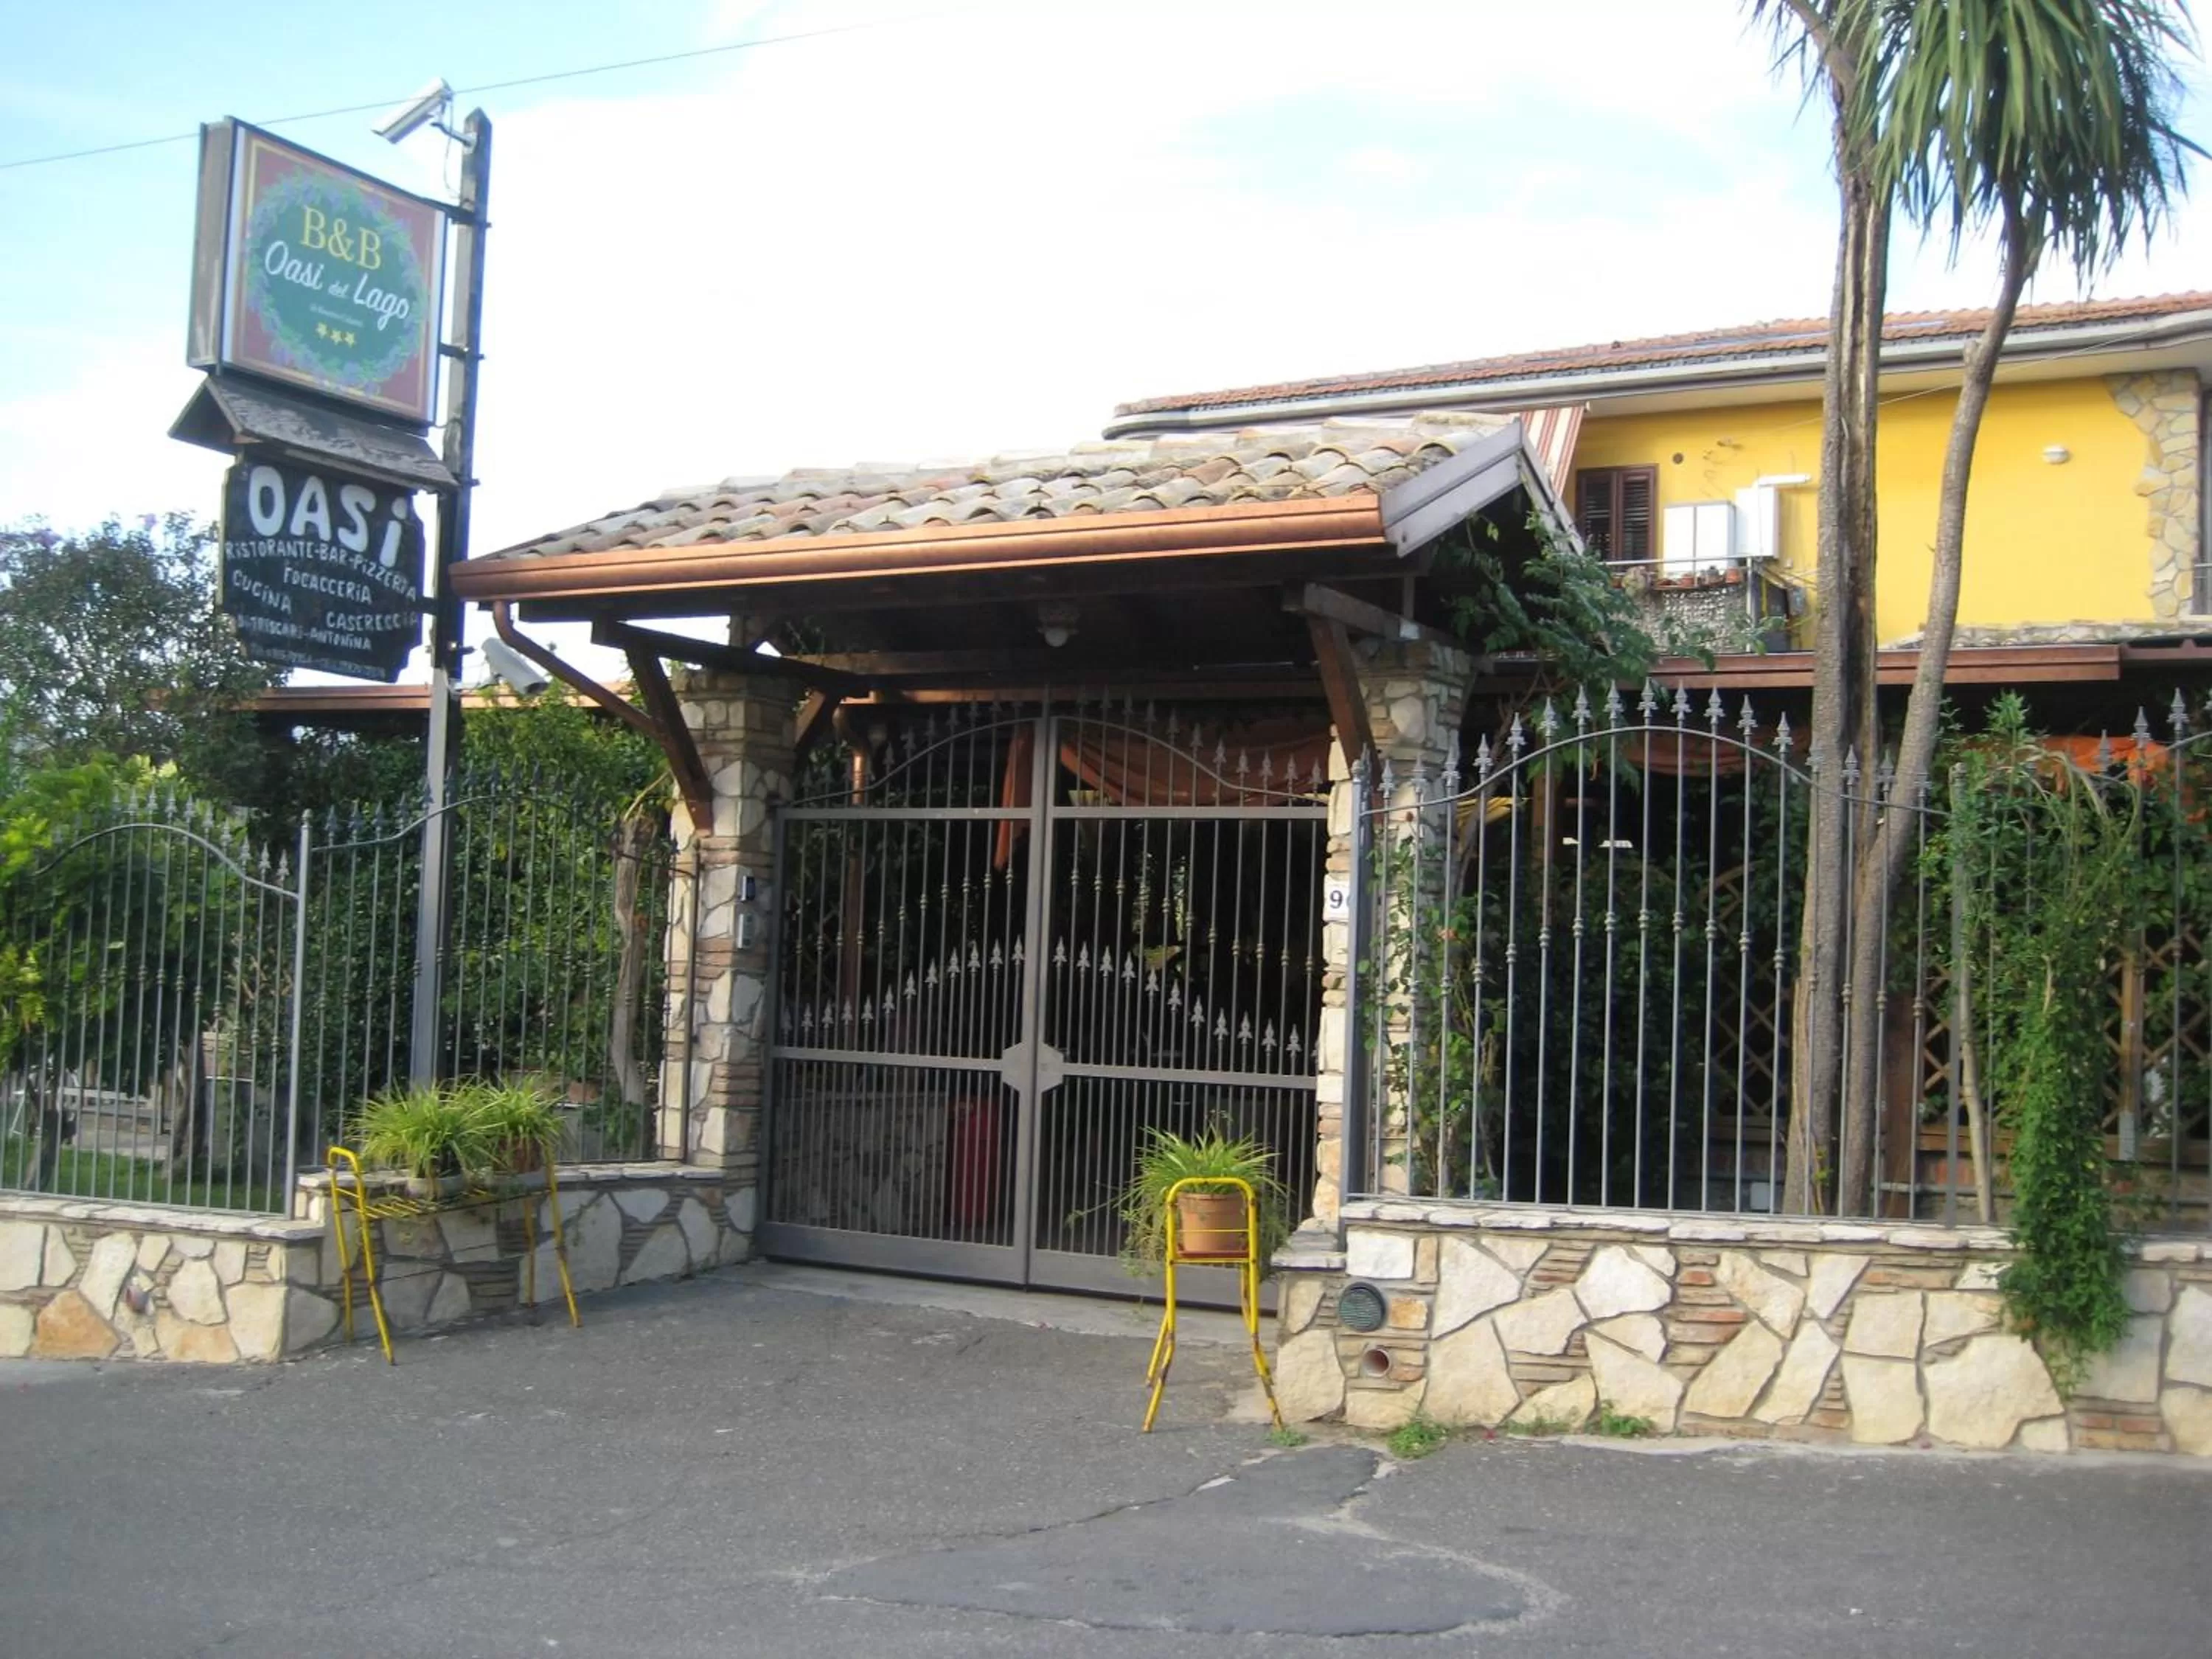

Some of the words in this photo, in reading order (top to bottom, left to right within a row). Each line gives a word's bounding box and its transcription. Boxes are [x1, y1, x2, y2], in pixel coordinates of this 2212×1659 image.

[300, 205, 382, 270] B&B
[265, 240, 324, 291] Oasi
[354, 273, 411, 331] Lago
